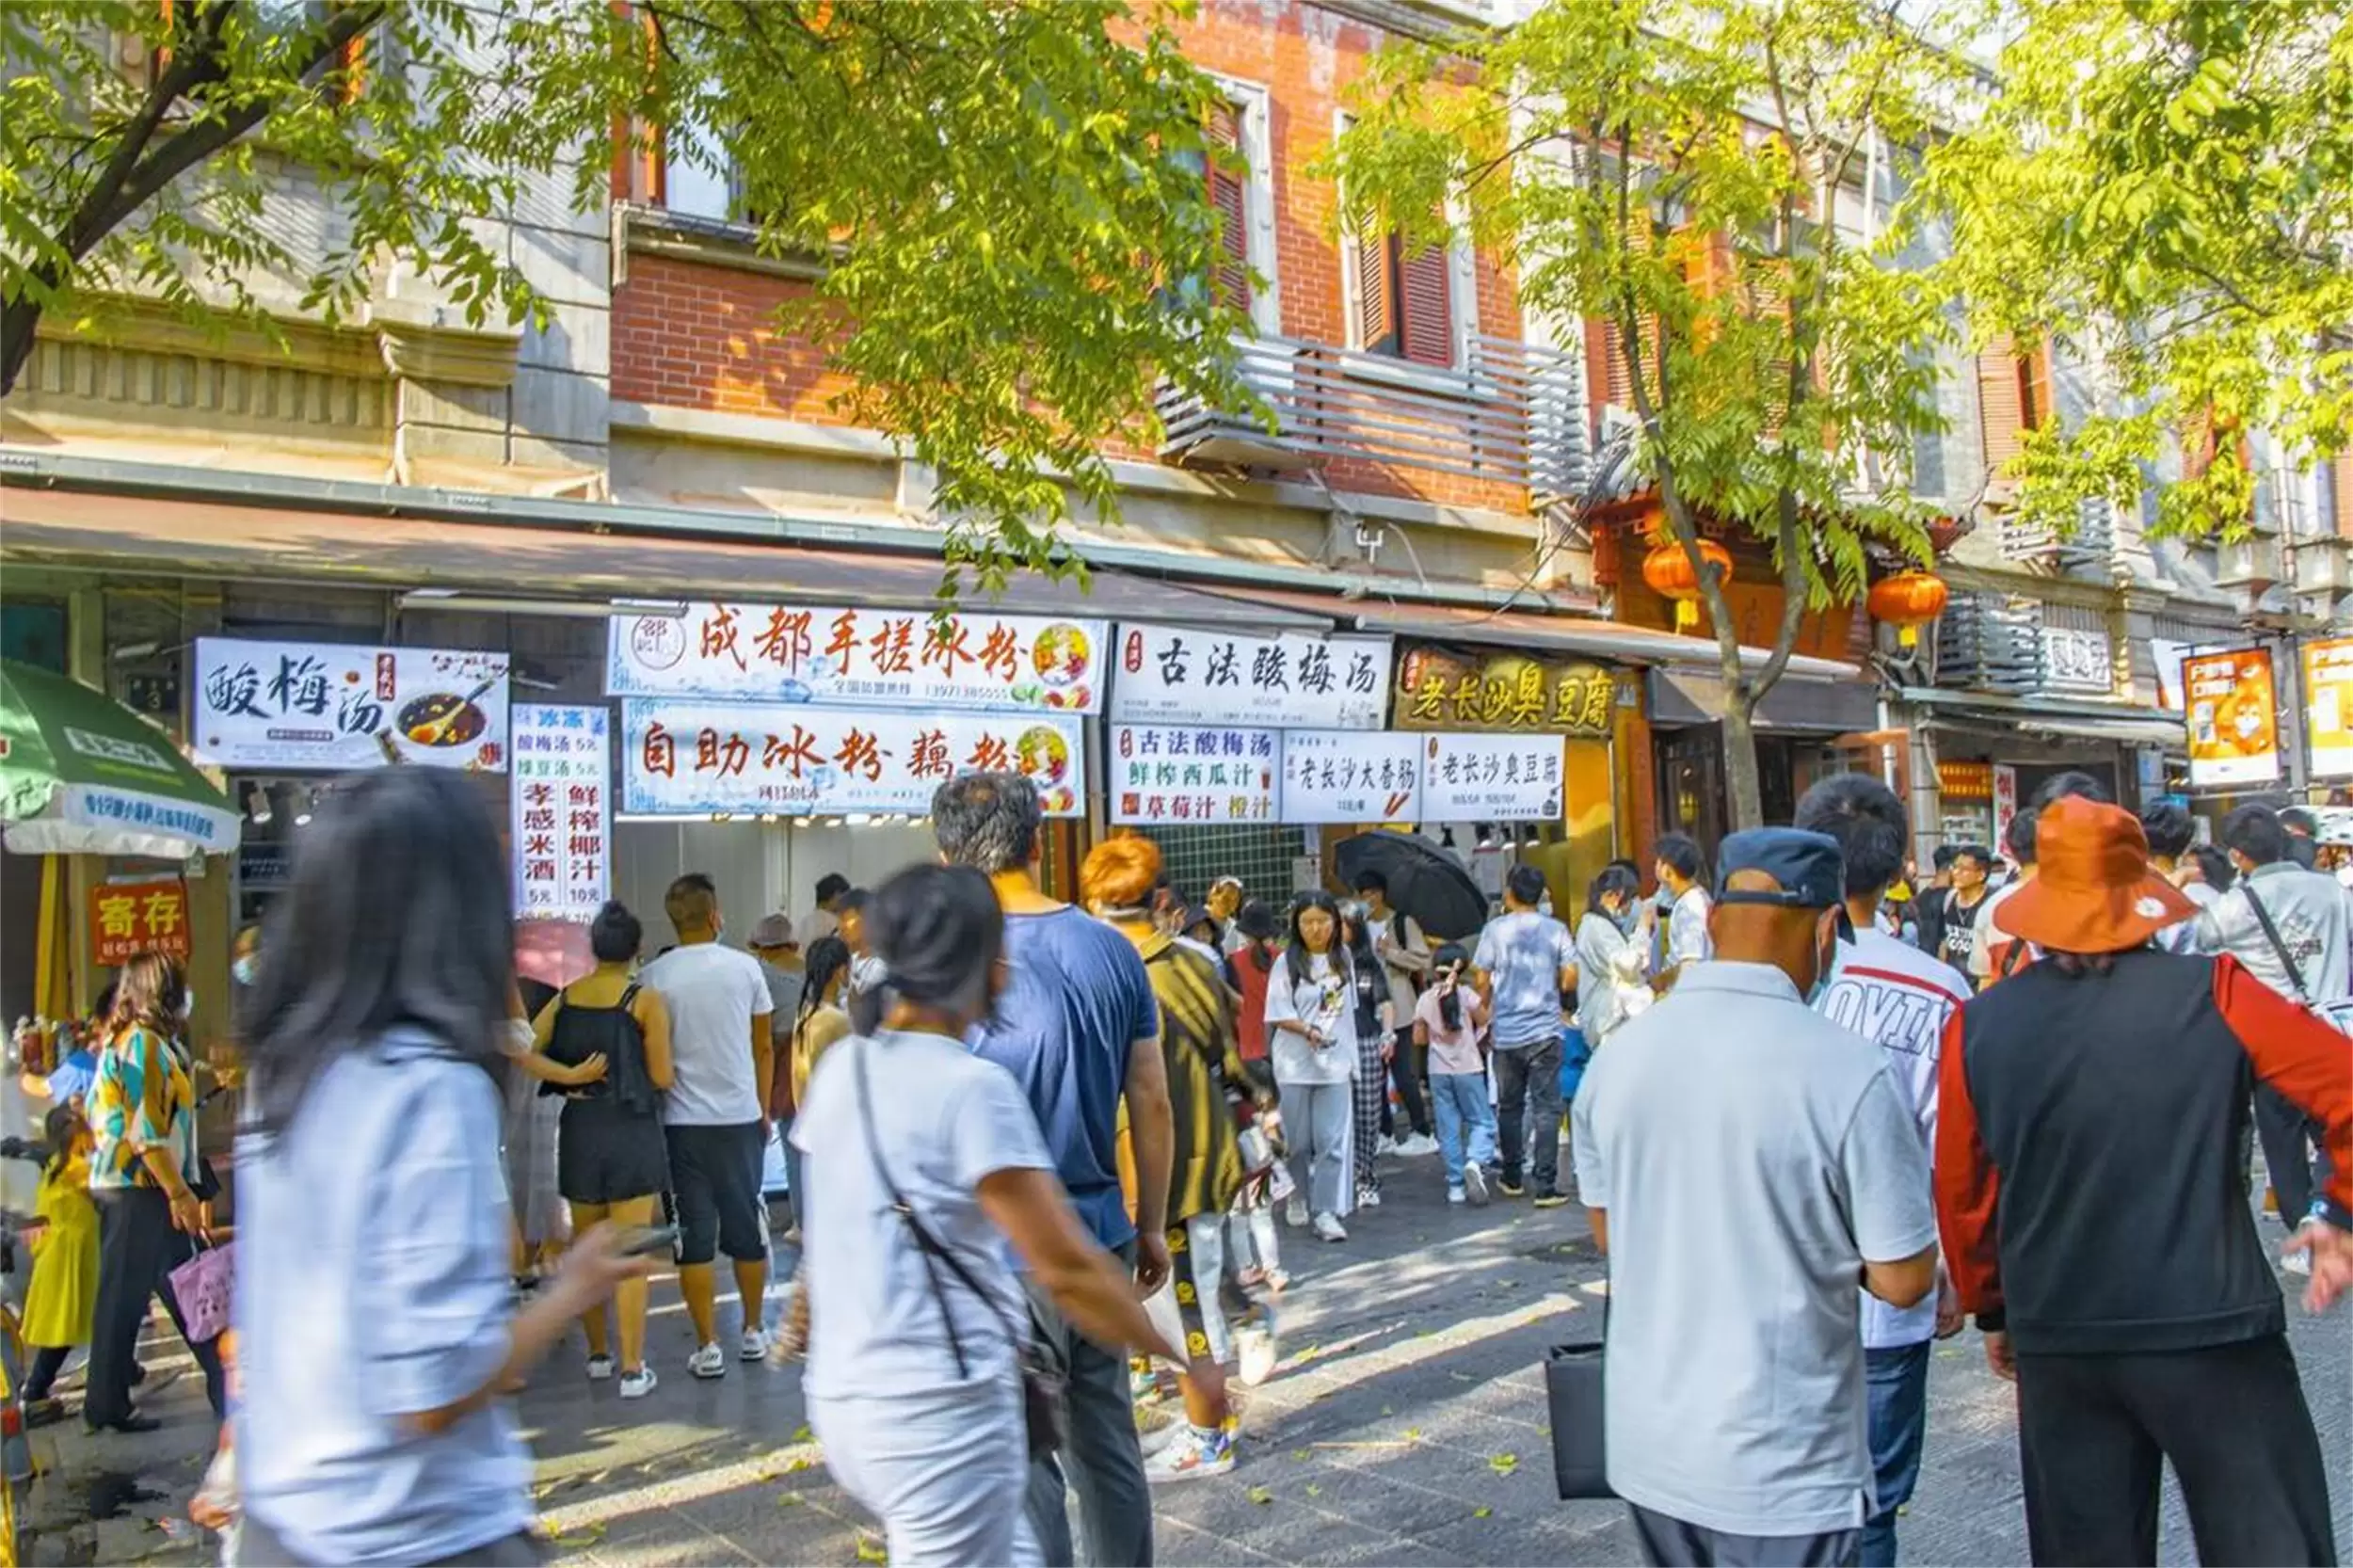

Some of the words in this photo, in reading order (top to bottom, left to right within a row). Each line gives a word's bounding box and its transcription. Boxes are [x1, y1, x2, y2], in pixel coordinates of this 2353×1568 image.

[699, 601, 1029, 682] 成都手搓冰粉
[1157, 638, 1377, 695] 古法酸梅汤
[205, 655, 383, 735] 酸梅汤
[1411, 662, 1614, 729] 老长沙臭豆腐
[1139, 729, 1272, 757] 古法酸梅汤
[1442, 752, 1558, 785] 老长沙臭豆腐
[1128, 760, 1254, 789] 鲜榨西瓜汁
[1299, 757, 1416, 791] 老长沙大香肠
[523, 782, 555, 882] 孝感米酒
[568, 783, 601, 882] 鲜榨椰汁
[1144, 795, 1216, 820] 草莓汁
[1228, 795, 1273, 820] 橙汁
[97, 890, 182, 938] 寄存
